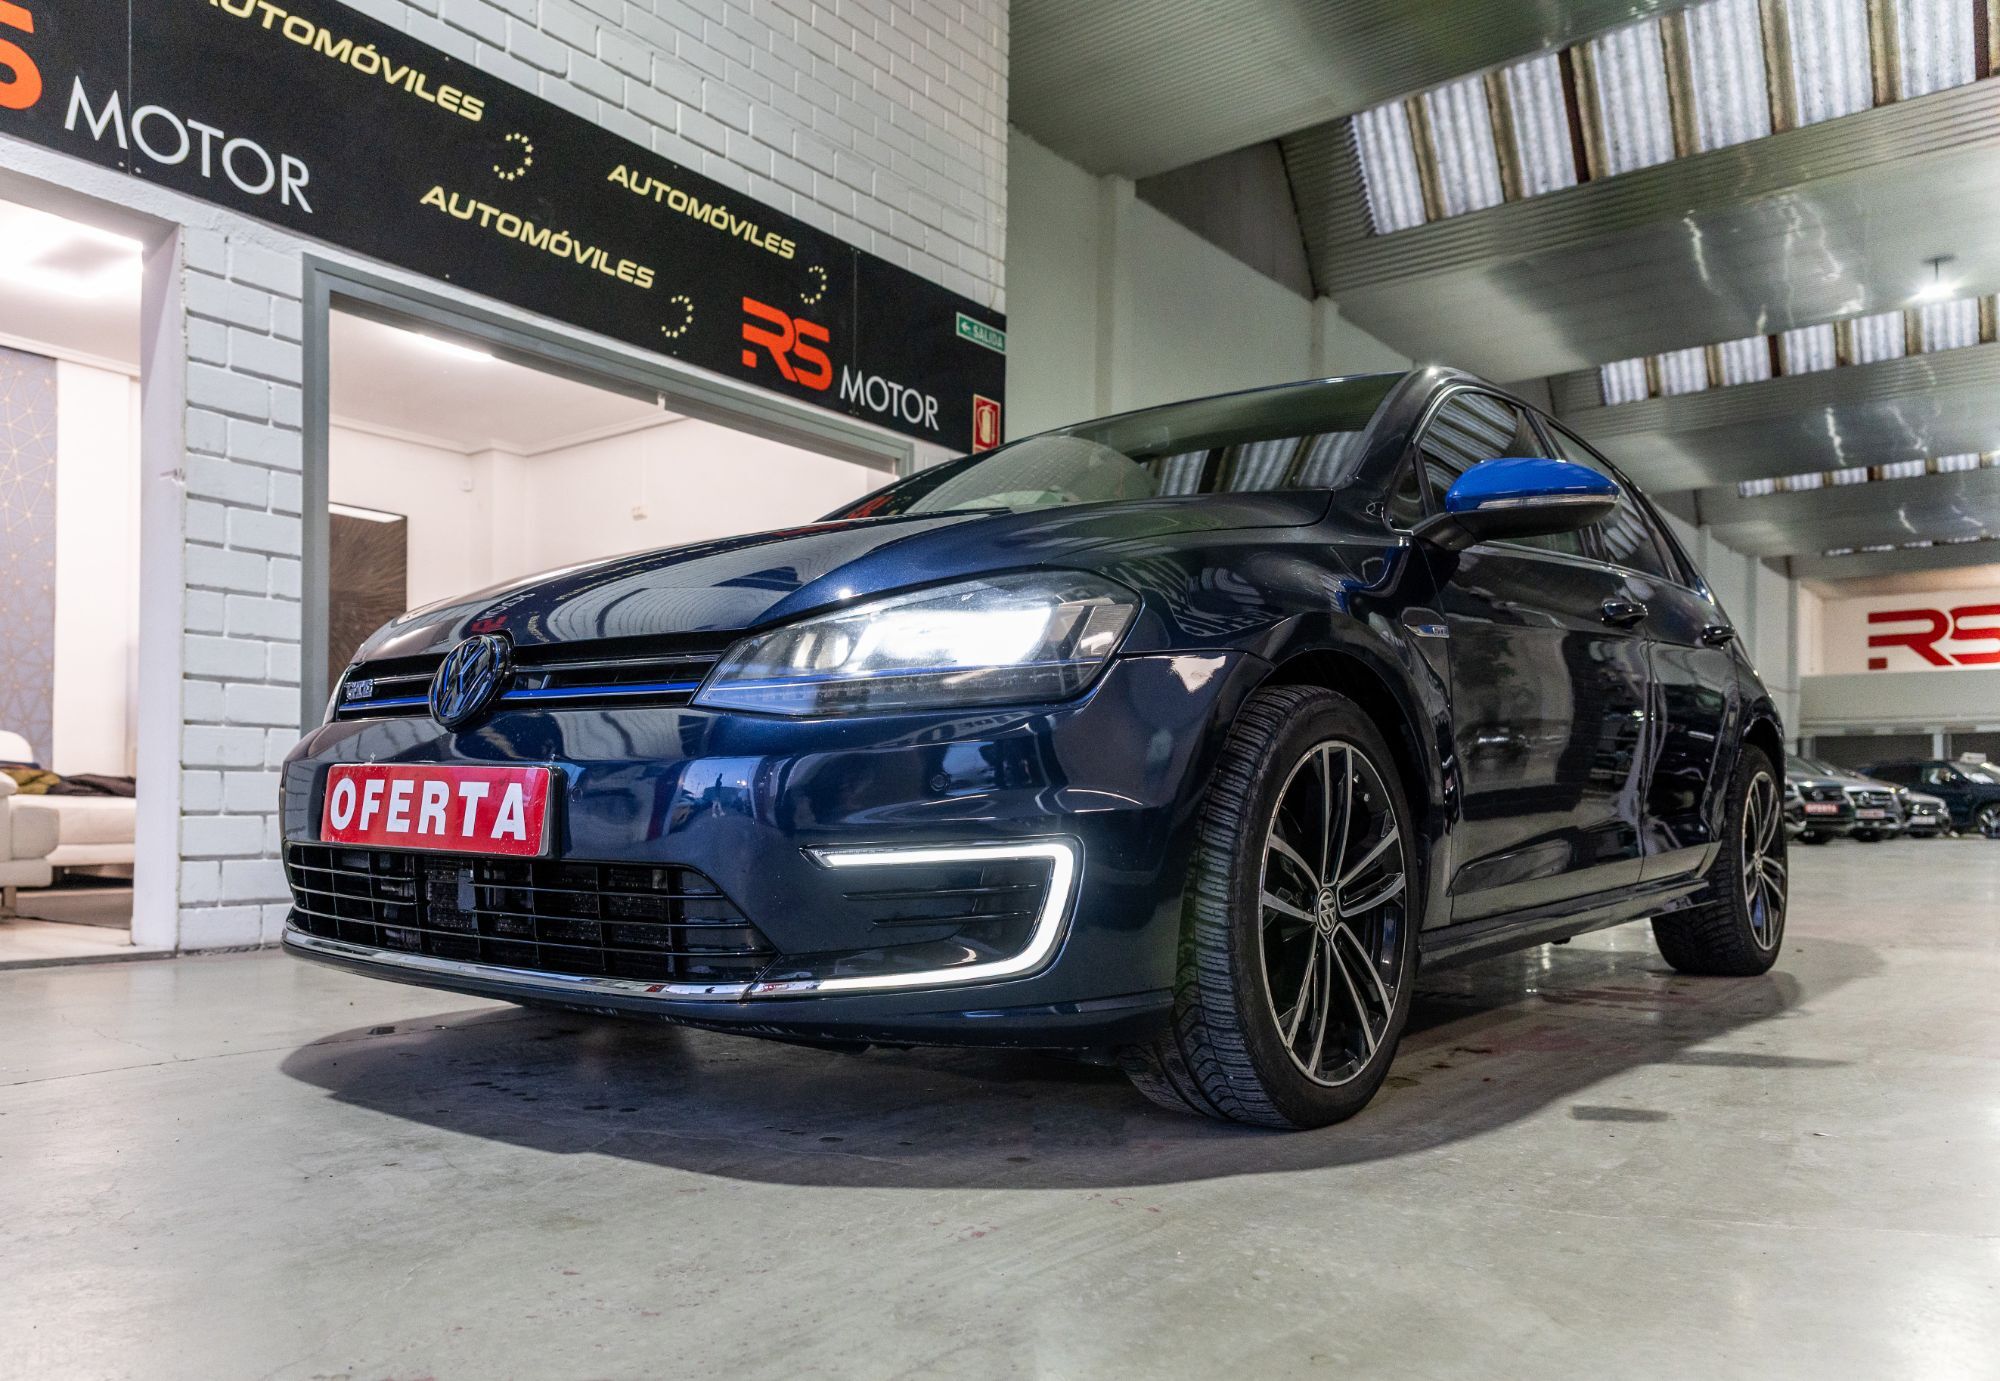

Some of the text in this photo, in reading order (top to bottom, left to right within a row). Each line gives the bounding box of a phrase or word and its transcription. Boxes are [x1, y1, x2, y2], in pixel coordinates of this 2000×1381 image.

[209, 0, 486, 121] UTOMÓVILES
[64, 74, 314, 214] MOTOR
[419, 185, 656, 289] AUTOMÓVILES
[607, 164, 797, 260] AUTOMÓVILES
[741, 296, 940, 431] RS MOTOR
[972, 324, 1003, 348] SALIDA
[330, 778, 528, 841] OFERTA
